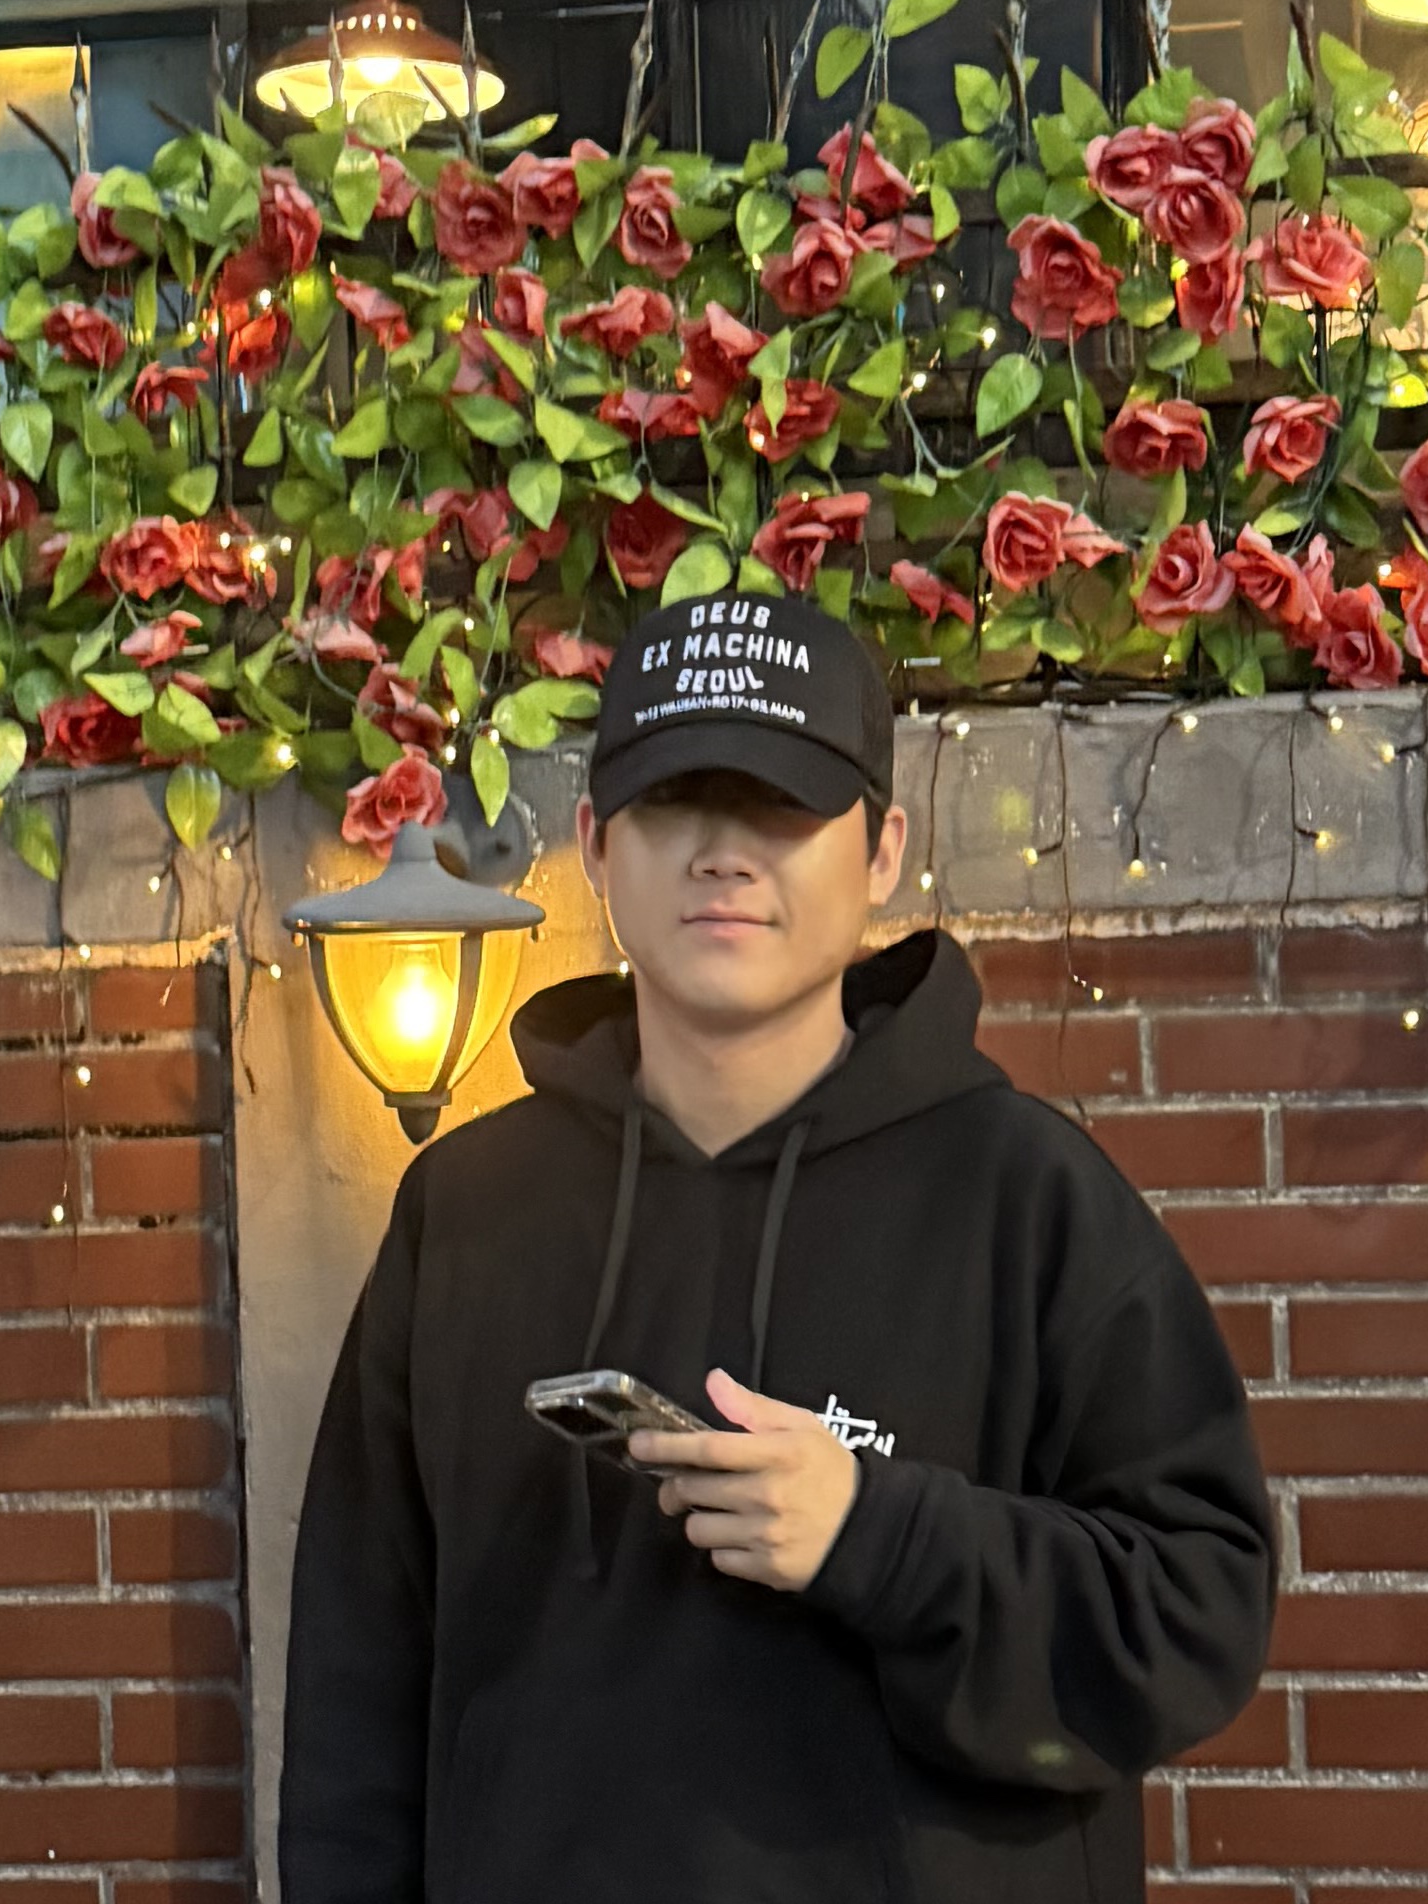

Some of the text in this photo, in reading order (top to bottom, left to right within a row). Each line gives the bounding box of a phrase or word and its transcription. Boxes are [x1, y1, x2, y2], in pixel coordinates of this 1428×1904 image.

[690, 600, 771, 629] DEUS
[641, 632, 811, 674] EX MACHINA
[675, 665, 765, 694] SEOUL
